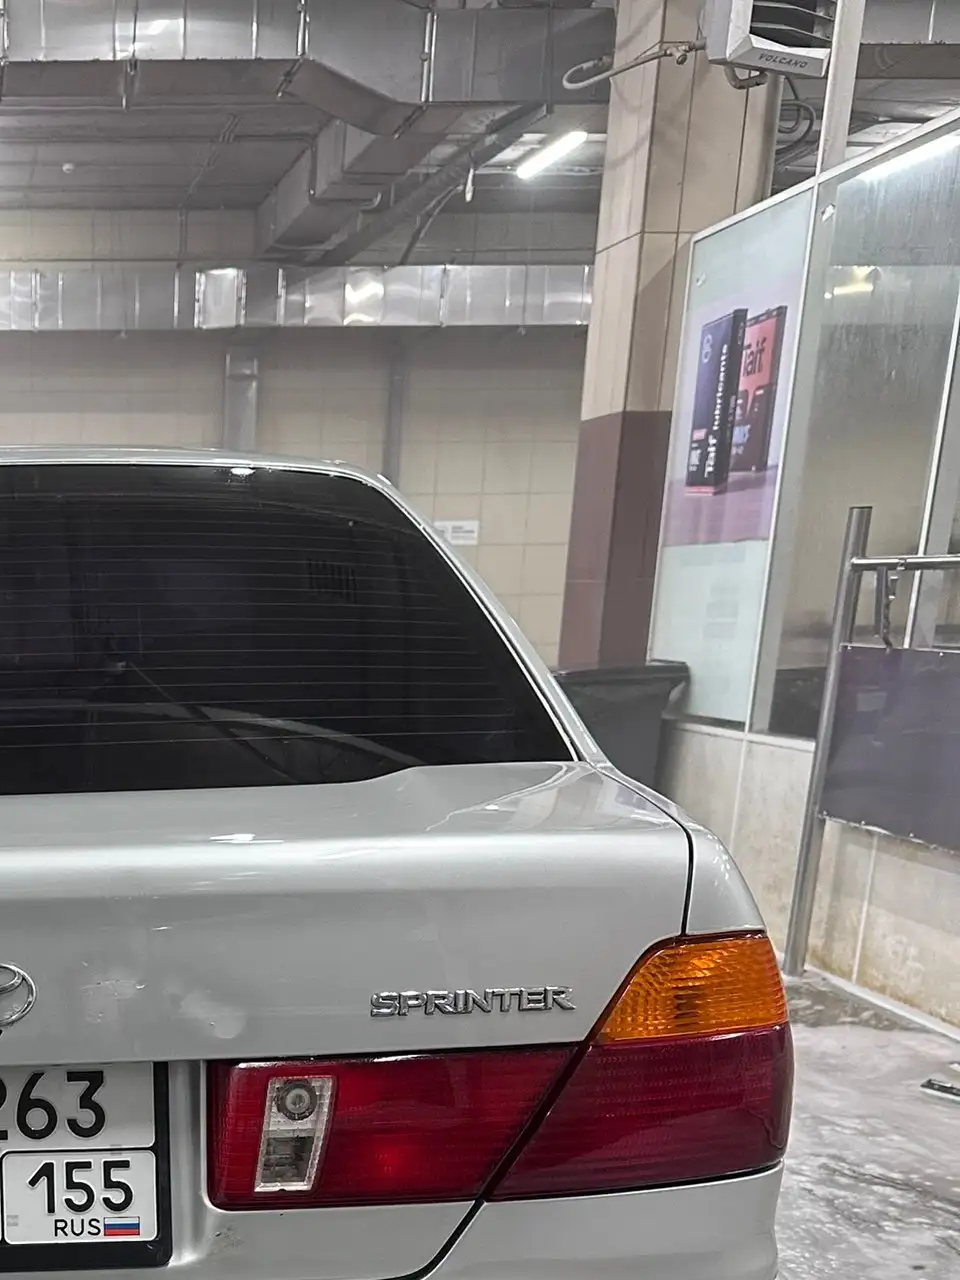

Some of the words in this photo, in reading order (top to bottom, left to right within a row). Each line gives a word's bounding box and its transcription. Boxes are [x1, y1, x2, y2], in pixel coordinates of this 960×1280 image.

[759, 52, 808, 68] VOLCANO
[370, 984, 576, 1017] SPRINTER
[27, 1159, 134, 1214] 155
[54, 1218, 101, 1237] RUS
